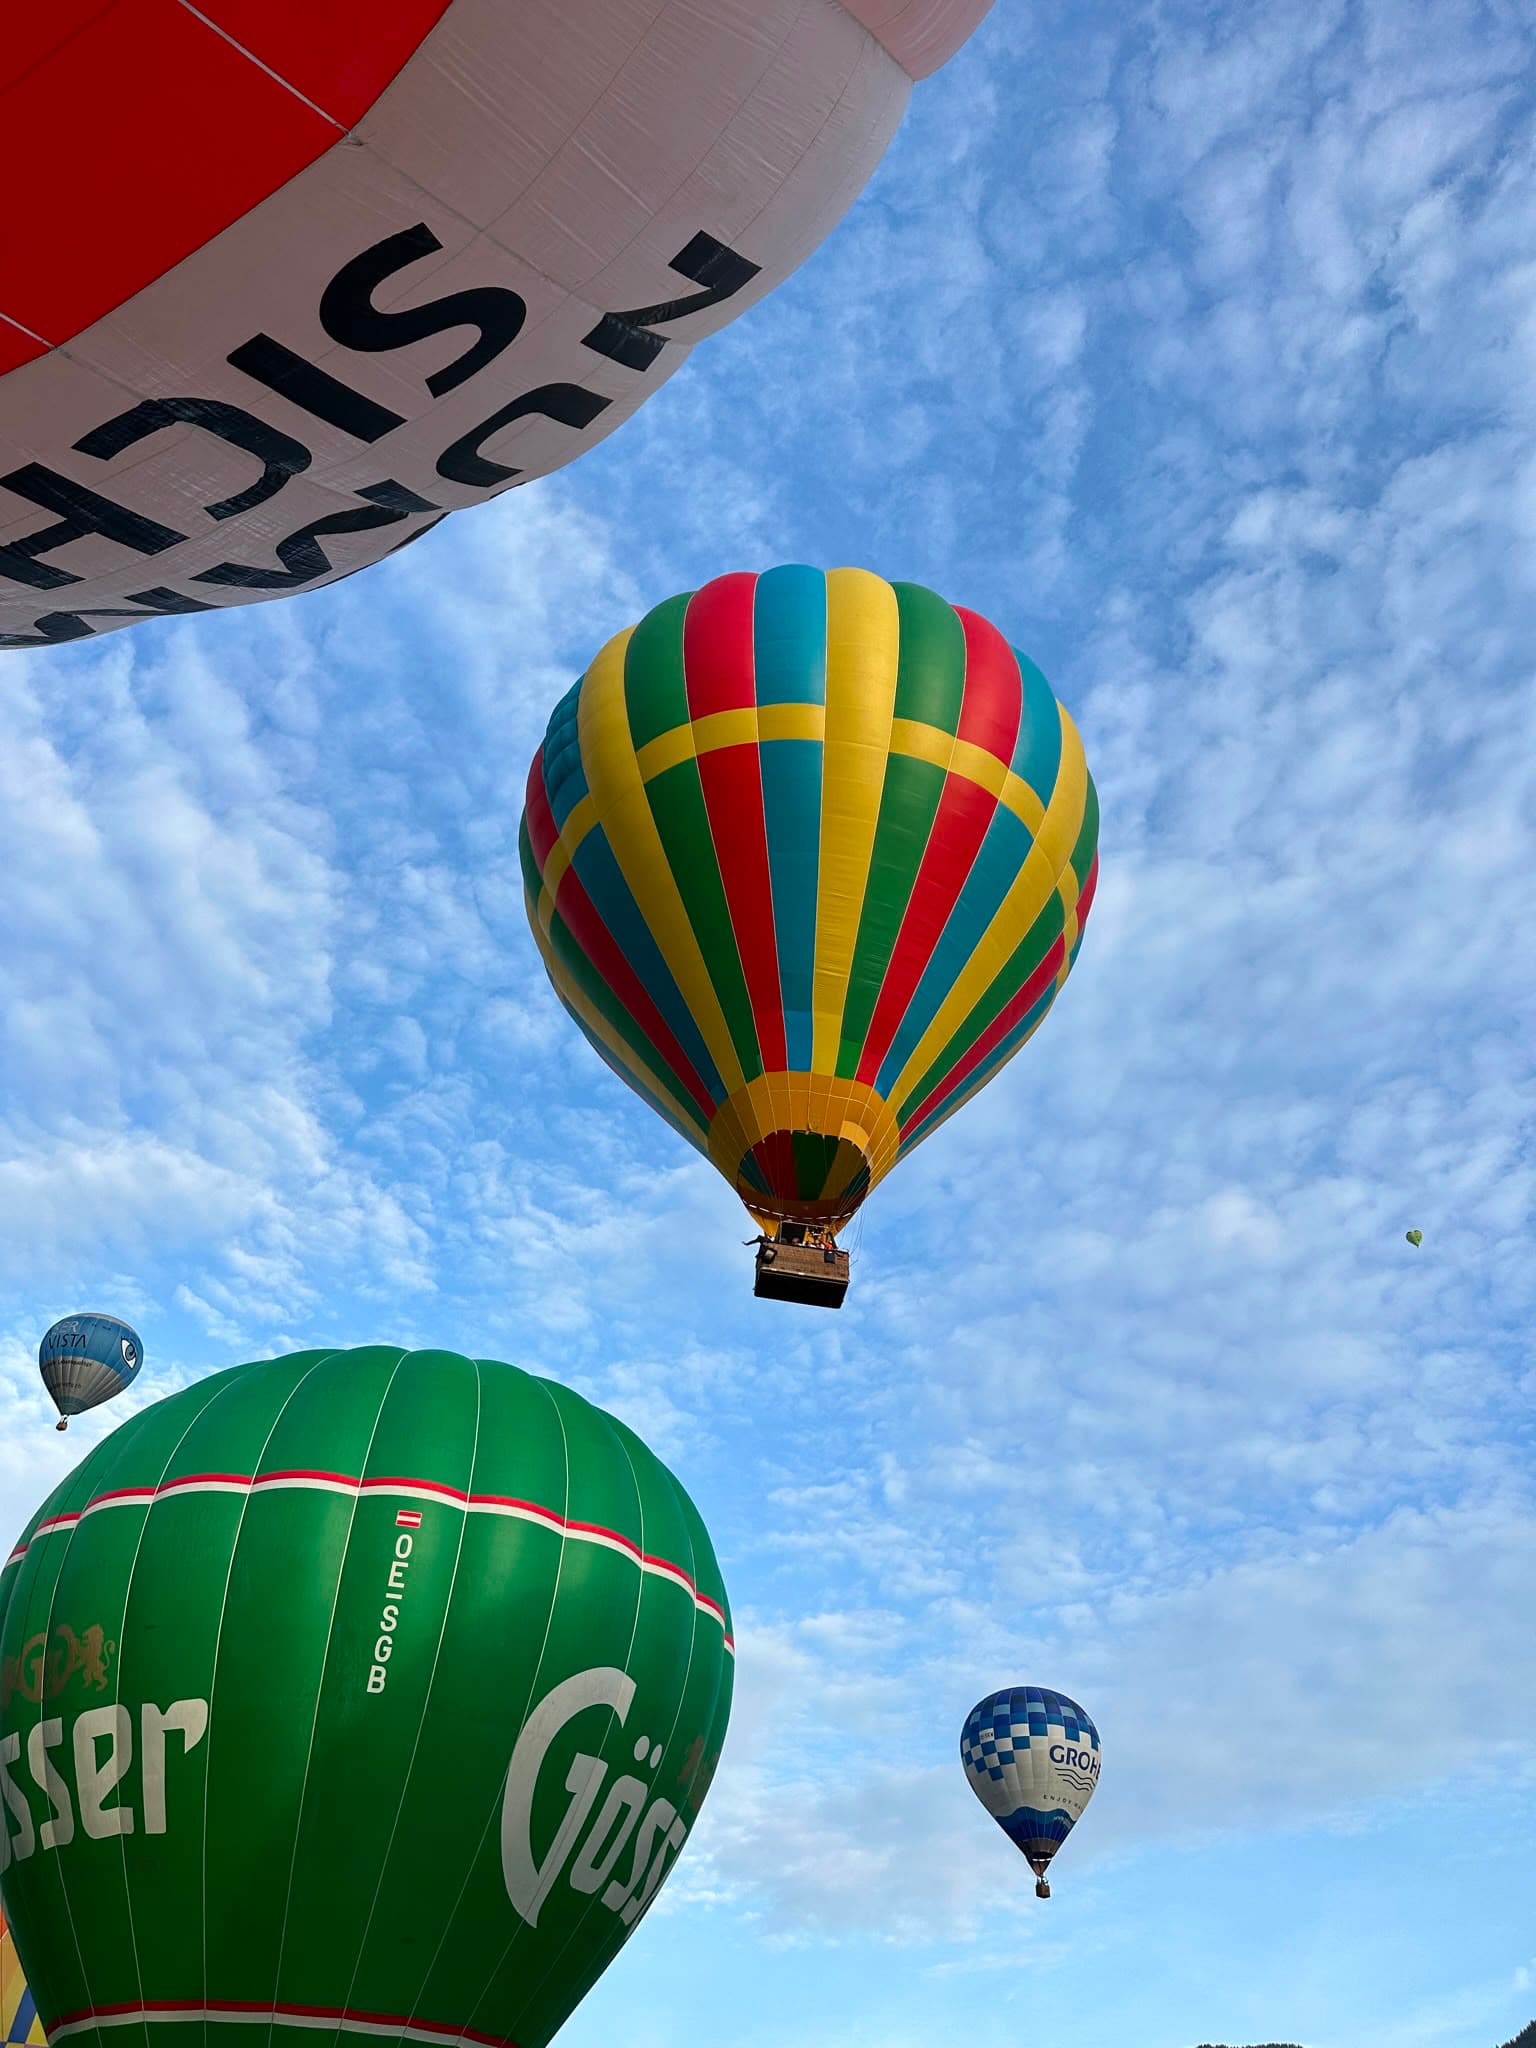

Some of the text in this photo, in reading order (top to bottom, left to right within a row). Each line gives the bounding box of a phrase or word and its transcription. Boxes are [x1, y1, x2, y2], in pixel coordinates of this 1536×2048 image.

[48, 1333, 86, 1349] VISTA
[0, 1698, 208, 1875] sser
[501, 1666, 687, 1940] Göss
